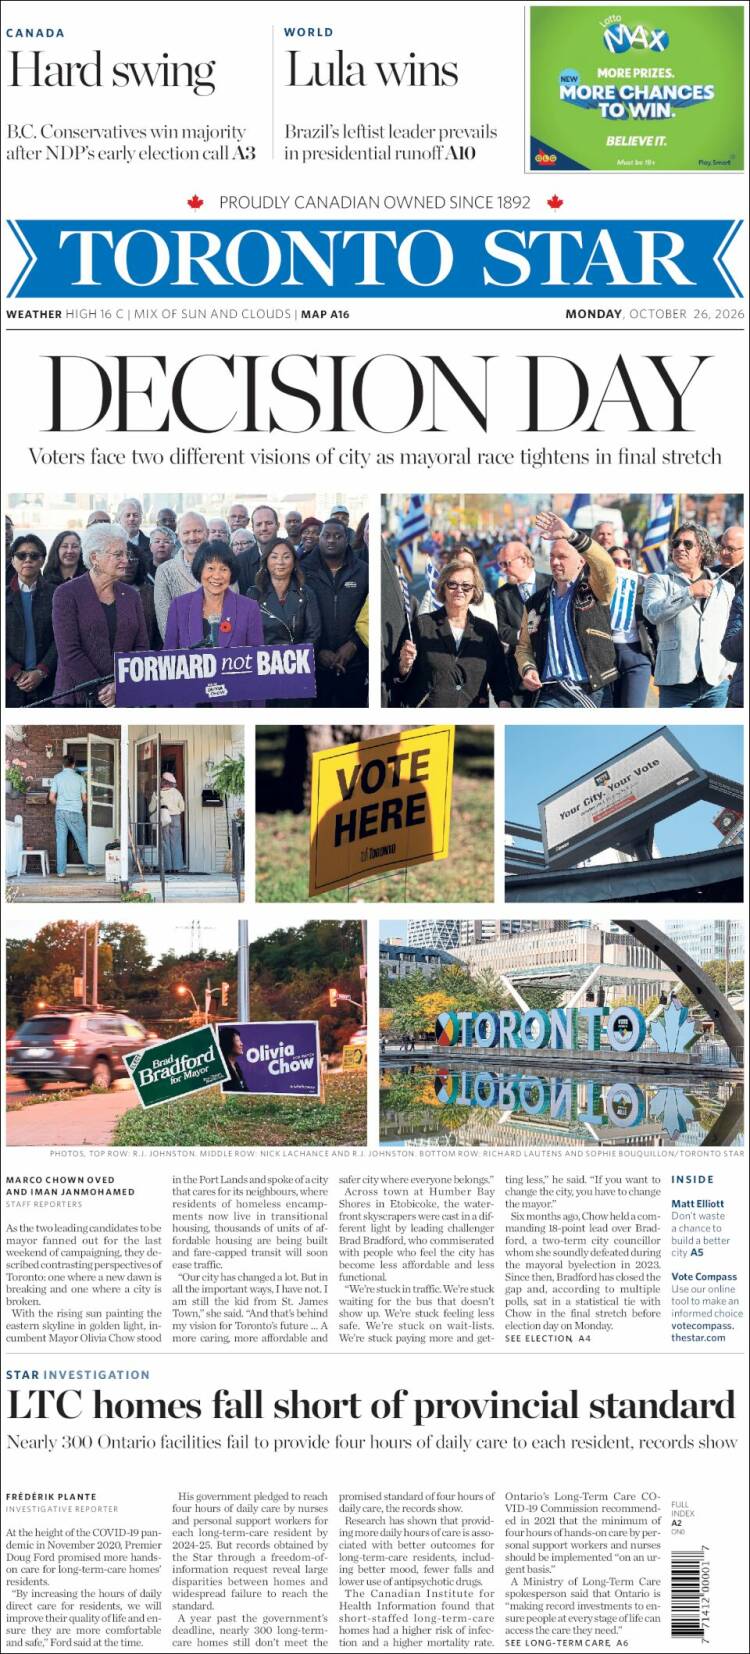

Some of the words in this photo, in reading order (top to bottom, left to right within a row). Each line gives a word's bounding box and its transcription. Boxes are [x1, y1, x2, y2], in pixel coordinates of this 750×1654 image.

[600, 14, 621, 28] Lotto
[6, 28, 64, 38] CANADA
[284, 27, 333, 37] WORLD
[604, 23, 666, 53] MAX
[8, 50, 103, 87] Hard
[112, 52, 216, 96] swing
[285, 49, 367, 86] Lula
[374, 52, 458, 87] wins
[597, 68, 631, 78] MORE
[633, 68, 674, 78] PRIZES.
[560, 85, 616, 99] MORE
[620, 85, 714, 99] CHANCES
[599, 103, 625, 117] TO
[628, 103, 676, 117] WIN.
[8, 124, 37, 139] B.C.
[40, 124, 147, 139] Conservatives
[150, 124, 178, 139] win
[182, 124, 246, 142] majority
[343, 124, 384, 139] leftist
[389, 123, 436, 139] leader
[439, 123, 498, 142] prevails
[606, 136, 653, 146] BELIEVE
[654, 136, 667, 146] IT.
[6, 145, 42, 160] after
[98, 145, 136, 164] early
[138, 145, 199, 160] election
[202, 145, 228, 160] call
[232, 145, 256, 160] A3
[285, 146, 298, 160] in
[302, 145, 391, 164] presidential
[395, 145, 444, 160] runoff
[444, 145, 476, 160] A10
[220, 196, 290, 210] PROUDLY
[294, 195, 380, 209] CANADIAN
[384, 196, 446, 209] OWNED
[450, 195, 493, 209] SINCE
[497, 196, 530, 210] 1892
[60, 230, 453, 286] TORONTO
[484, 230, 695, 286] STAR
[6, 310, 62, 319] WEATHER
[66, 308, 96, 319] HIGH
[100, 309, 112, 318] 16
[116, 309, 123, 318] C
[134, 309, 158, 319] MIX
[162, 309, 177, 318] OF
[182, 309, 206, 319] SUN
[210, 308, 238, 319] AND
[242, 309, 290, 319] CLOUDS
[301, 310, 327, 319] MAP
[330, 310, 350, 319] A16
[565, 309, 625, 320] MONDAY,
[630, 308, 686, 319] OCTOBER
[694, 309, 710, 319] 26,
[715, 309, 744, 319] 2026
[40, 354, 499, 434] DECISION
[517, 353, 714, 432] DAY
[28, 447, 85, 464] Voters
[91, 447, 126, 464] face
[132, 449, 164, 464] two
[170, 447, 244, 464] different
[250, 448, 310, 464] visions
[316, 447, 336, 464] of
[338, 448, 371, 469] city
[376, 453, 394, 464] as
[400, 447, 470, 469] mayoral
[478, 453, 514, 464] race
[520, 447, 590, 468] tightens
[596, 448, 612, 464] in
[618, 447, 656, 464] final
[662, 447, 722, 464] stretch
[118, 653, 217, 683] FORWARD
[221, 654, 253, 671] not
[257, 649, 311, 675] BACK
[336, 749, 430, 801] VOTE
[560, 805, 580, 820] Your
[583, 792, 606, 806] City.
[608, 775, 631, 791] Your
[633, 760, 660, 776] Vote
[334, 792, 426, 848] HERE
[458, 1007, 646, 1051] TORONTO
[246, 1042, 294, 1063] Olivia
[138, 1045, 215, 1087] Bradford
[152, 1054, 174, 1069] Brad
[268, 1057, 314, 1076] Chow
[170, 1076, 182, 1085] for
[184, 1066, 209, 1080] Mayor
[672, 1175, 714, 1184] INSIDE
[344, 1188, 378, 1196] Across
[384, 1188, 408, 1196] town
[430, 1187, 472, 1196] Humber
[477, 1187, 495, 1198] Bay
[672, 1200, 695, 1208] Matt
[696, 1199, 724, 1208] Elliott
[672, 1248, 688, 1258] city
[671, 1272, 694, 1281] Vote
[695, 1272, 738, 1283] Compass
[11, 1308, 35, 1318] With
[38, 1308, 53, 1318] the
[57, 1309, 83, 1319] rising
[106, 1309, 144, 1319] painting
[147, 1308, 162, 1318] the
[672, 1322, 734, 1332] votecompass.
[505, 1334, 521, 1342] SEE
[671, 1333, 726, 1342] thestar.com
[6, 1370, 39, 1380] STAR
[44, 1370, 149, 1380] INVESTIGATION
[7, 1389, 82, 1420] LTC
[92, 1389, 202, 1419] homes
[212, 1388, 264, 1419] fall
[274, 1389, 362, 1419] short
[370, 1388, 409, 1419] of
[413, 1389, 580, 1426] provincial
[589, 1389, 736, 1419] standard
[6, 1492, 54, 1500] FRÉDÉRIK
[172, 1577, 222, 1588] disparities
[228, 1577, 268, 1586] between
[274, 1577, 306, 1586] homes
[310, 1577, 328, 1586] and
[510, 1577, 518, 1586] A
[523, 1577, 564, 1588] Ministry
[568, 1577, 578, 1586] of
[582, 1577, 634, 1588] Long-Term
[638, 1577, 661, 1586] Care
